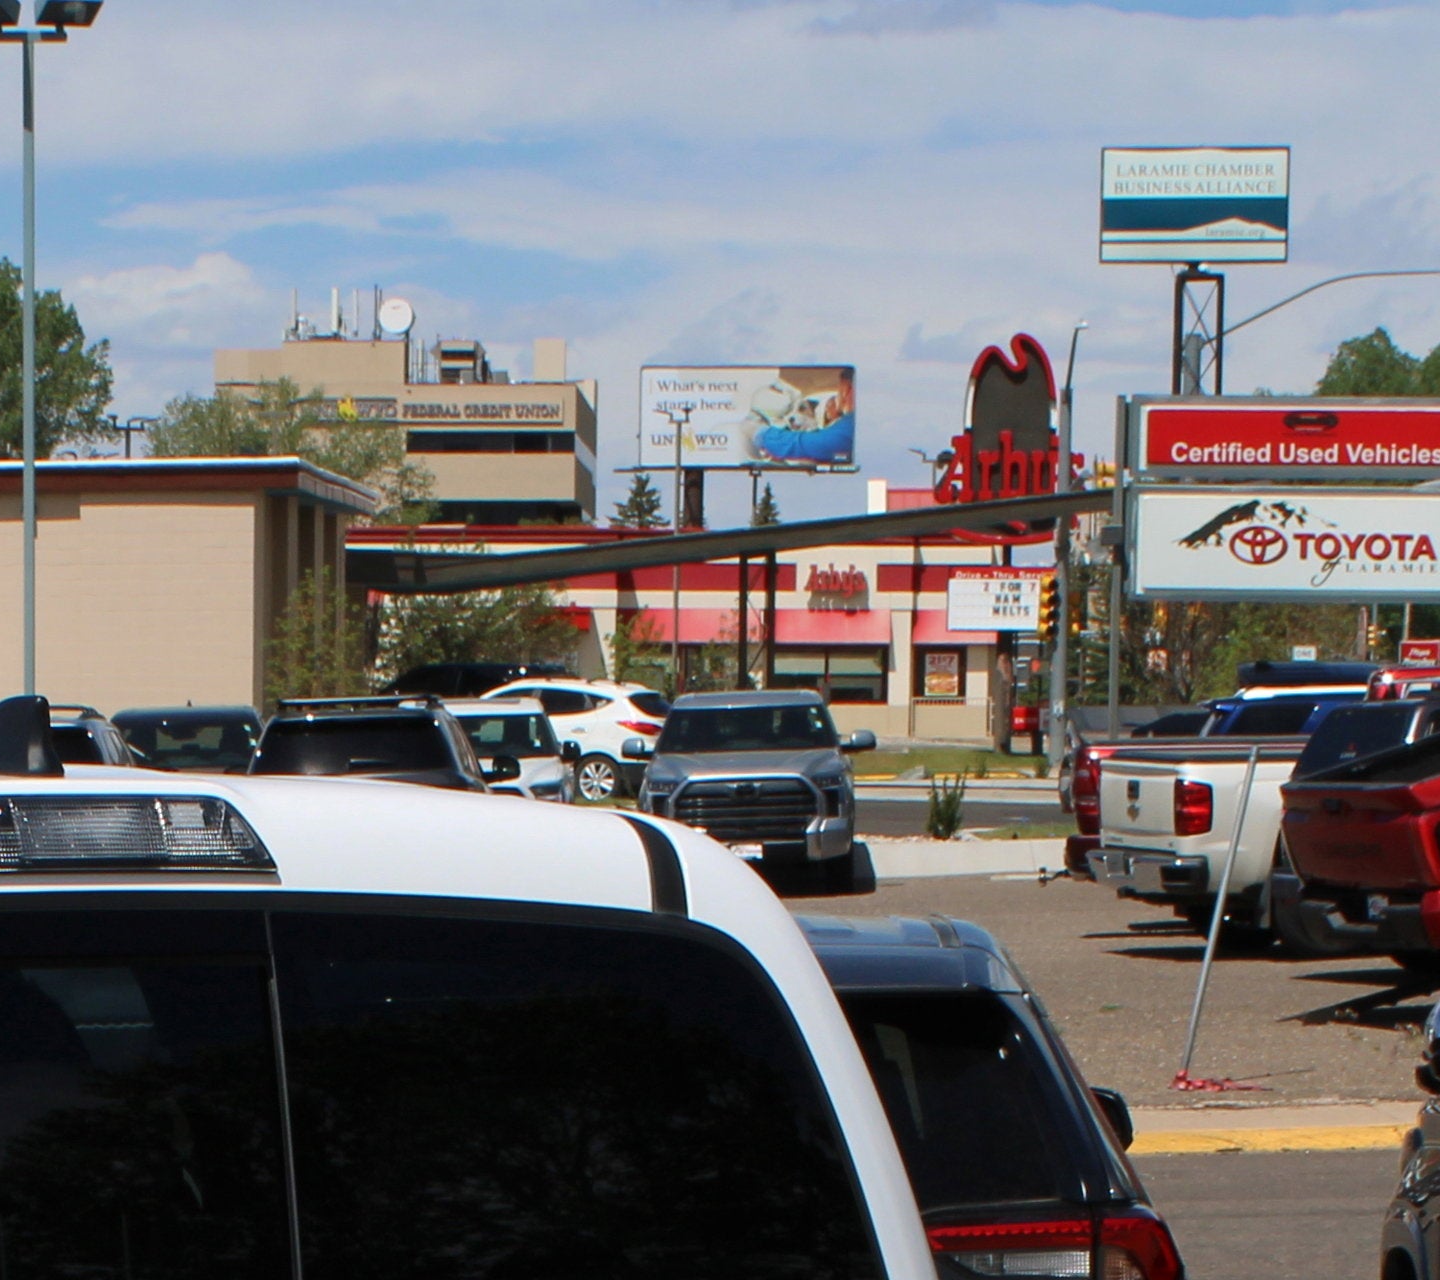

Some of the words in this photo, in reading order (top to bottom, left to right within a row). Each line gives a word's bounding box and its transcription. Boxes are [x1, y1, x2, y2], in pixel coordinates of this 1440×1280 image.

[1116, 164, 1189, 177] LARAMIE
[1194, 164, 1275, 177] CHAMBER
[1114, 180, 1191, 194] BUSINESS
[1195, 180, 1277, 194] ALLIANCE
[656, 380, 705, 392] What's
[708, 381, 738, 392] next
[403, 403, 462, 419] FEDERAL
[464, 403, 512, 419] CREDIT
[515, 403, 560, 419] UNION
[656, 400, 697, 411] starts
[700, 399, 736, 411] here.
[651, 434, 675, 447] UN
[1171, 442, 1271, 464] Certified
[1278, 442, 1339, 464] Used
[1293, 533, 1437, 561] TOYOTA
[1345, 563, 1439, 574] LARAMIE
